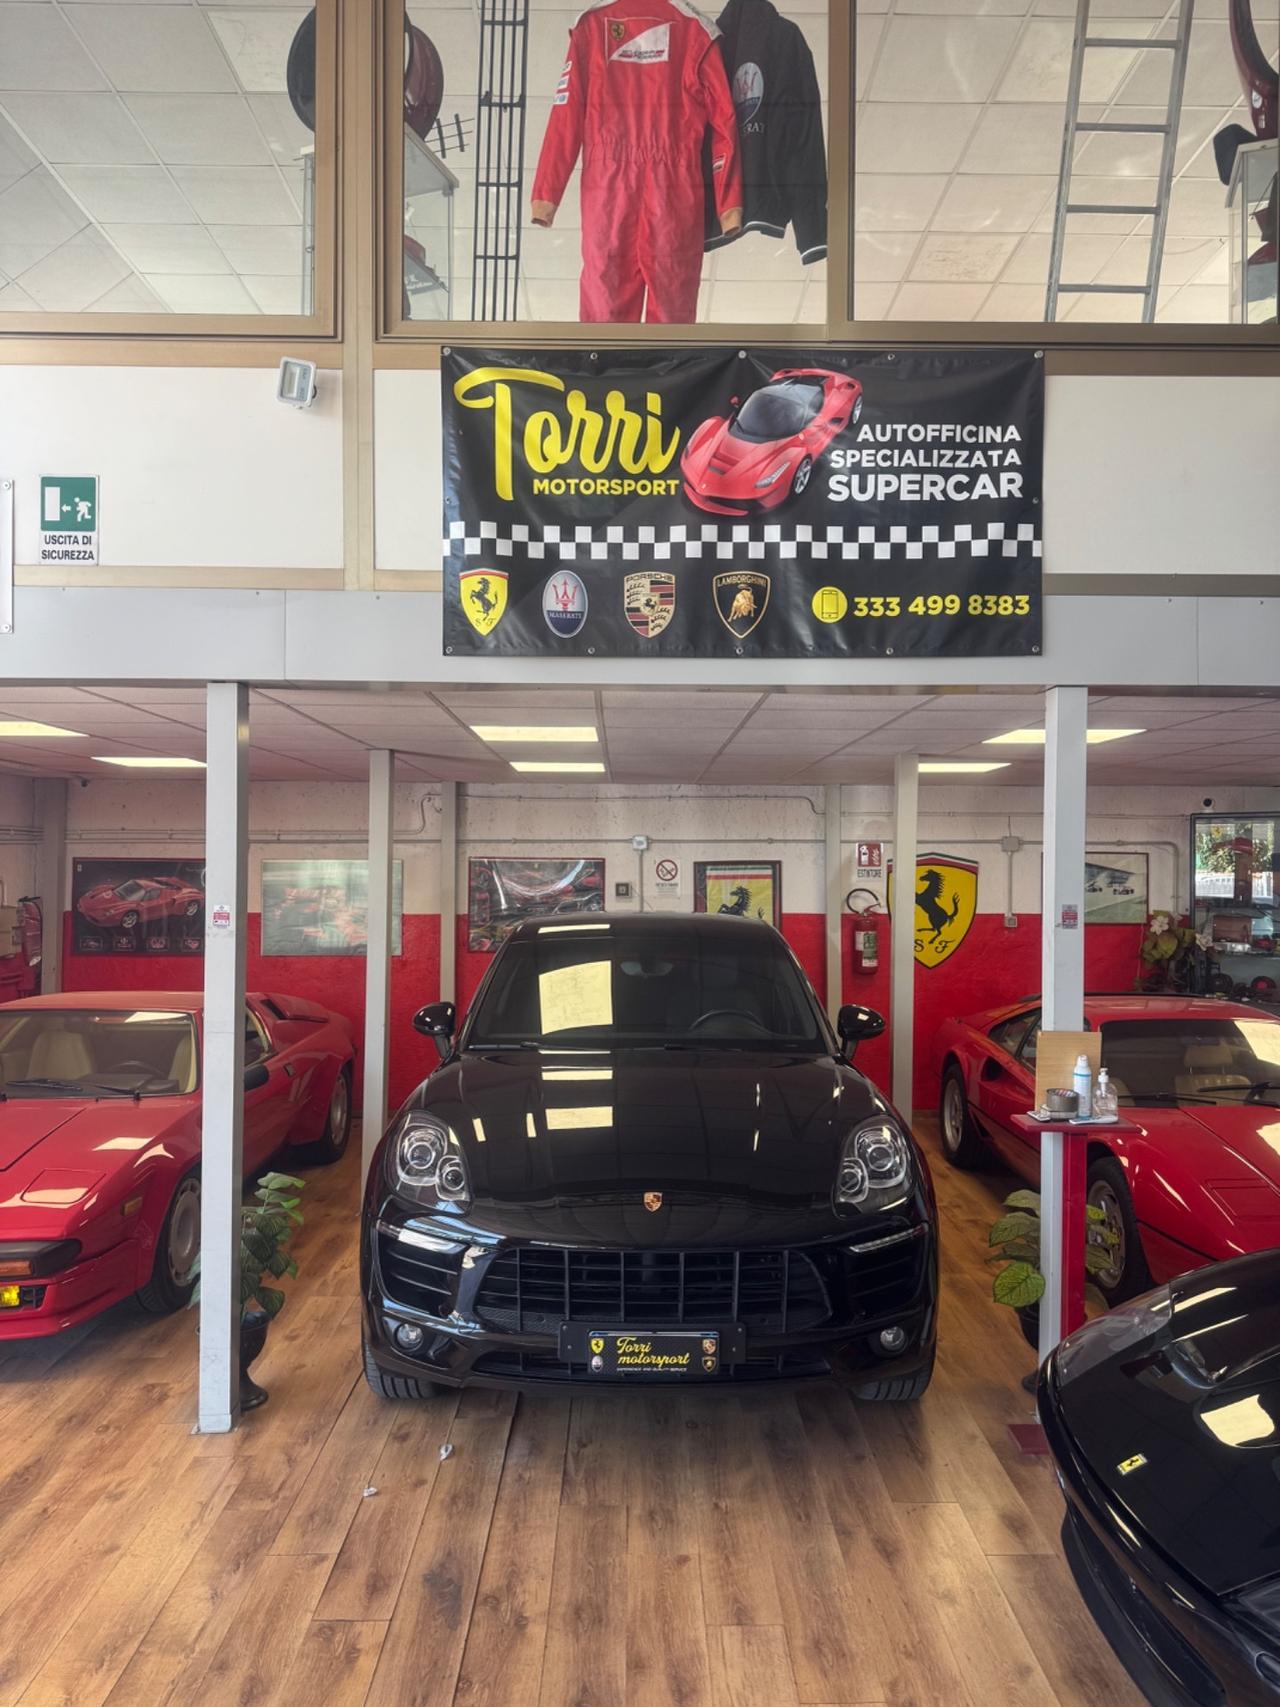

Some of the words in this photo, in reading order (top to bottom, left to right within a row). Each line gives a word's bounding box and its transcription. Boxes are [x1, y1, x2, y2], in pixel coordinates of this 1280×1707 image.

[454, 367, 681, 501] Torri
[857, 424, 1022, 443] AUTOFFICINA
[830, 448, 1022, 468] SPECIALIZZATA
[533, 478, 679, 496] MOTORSPORT
[827, 472, 1024, 502] SUPERCAR
[44, 534, 79, 545] USCITA
[82, 535, 92, 545] DI
[41, 549, 95, 560] SICUREZZA
[625, 572, 674, 583] PORSCHE
[717, 574, 767, 588] LAMBORGHINI
[853, 597, 901, 617] 333
[908, 594, 961, 616] 499
[967, 594, 1030, 616] 8383
[616, 1336, 652, 1354] Torri
[617, 1352, 690, 1368] motorsport
